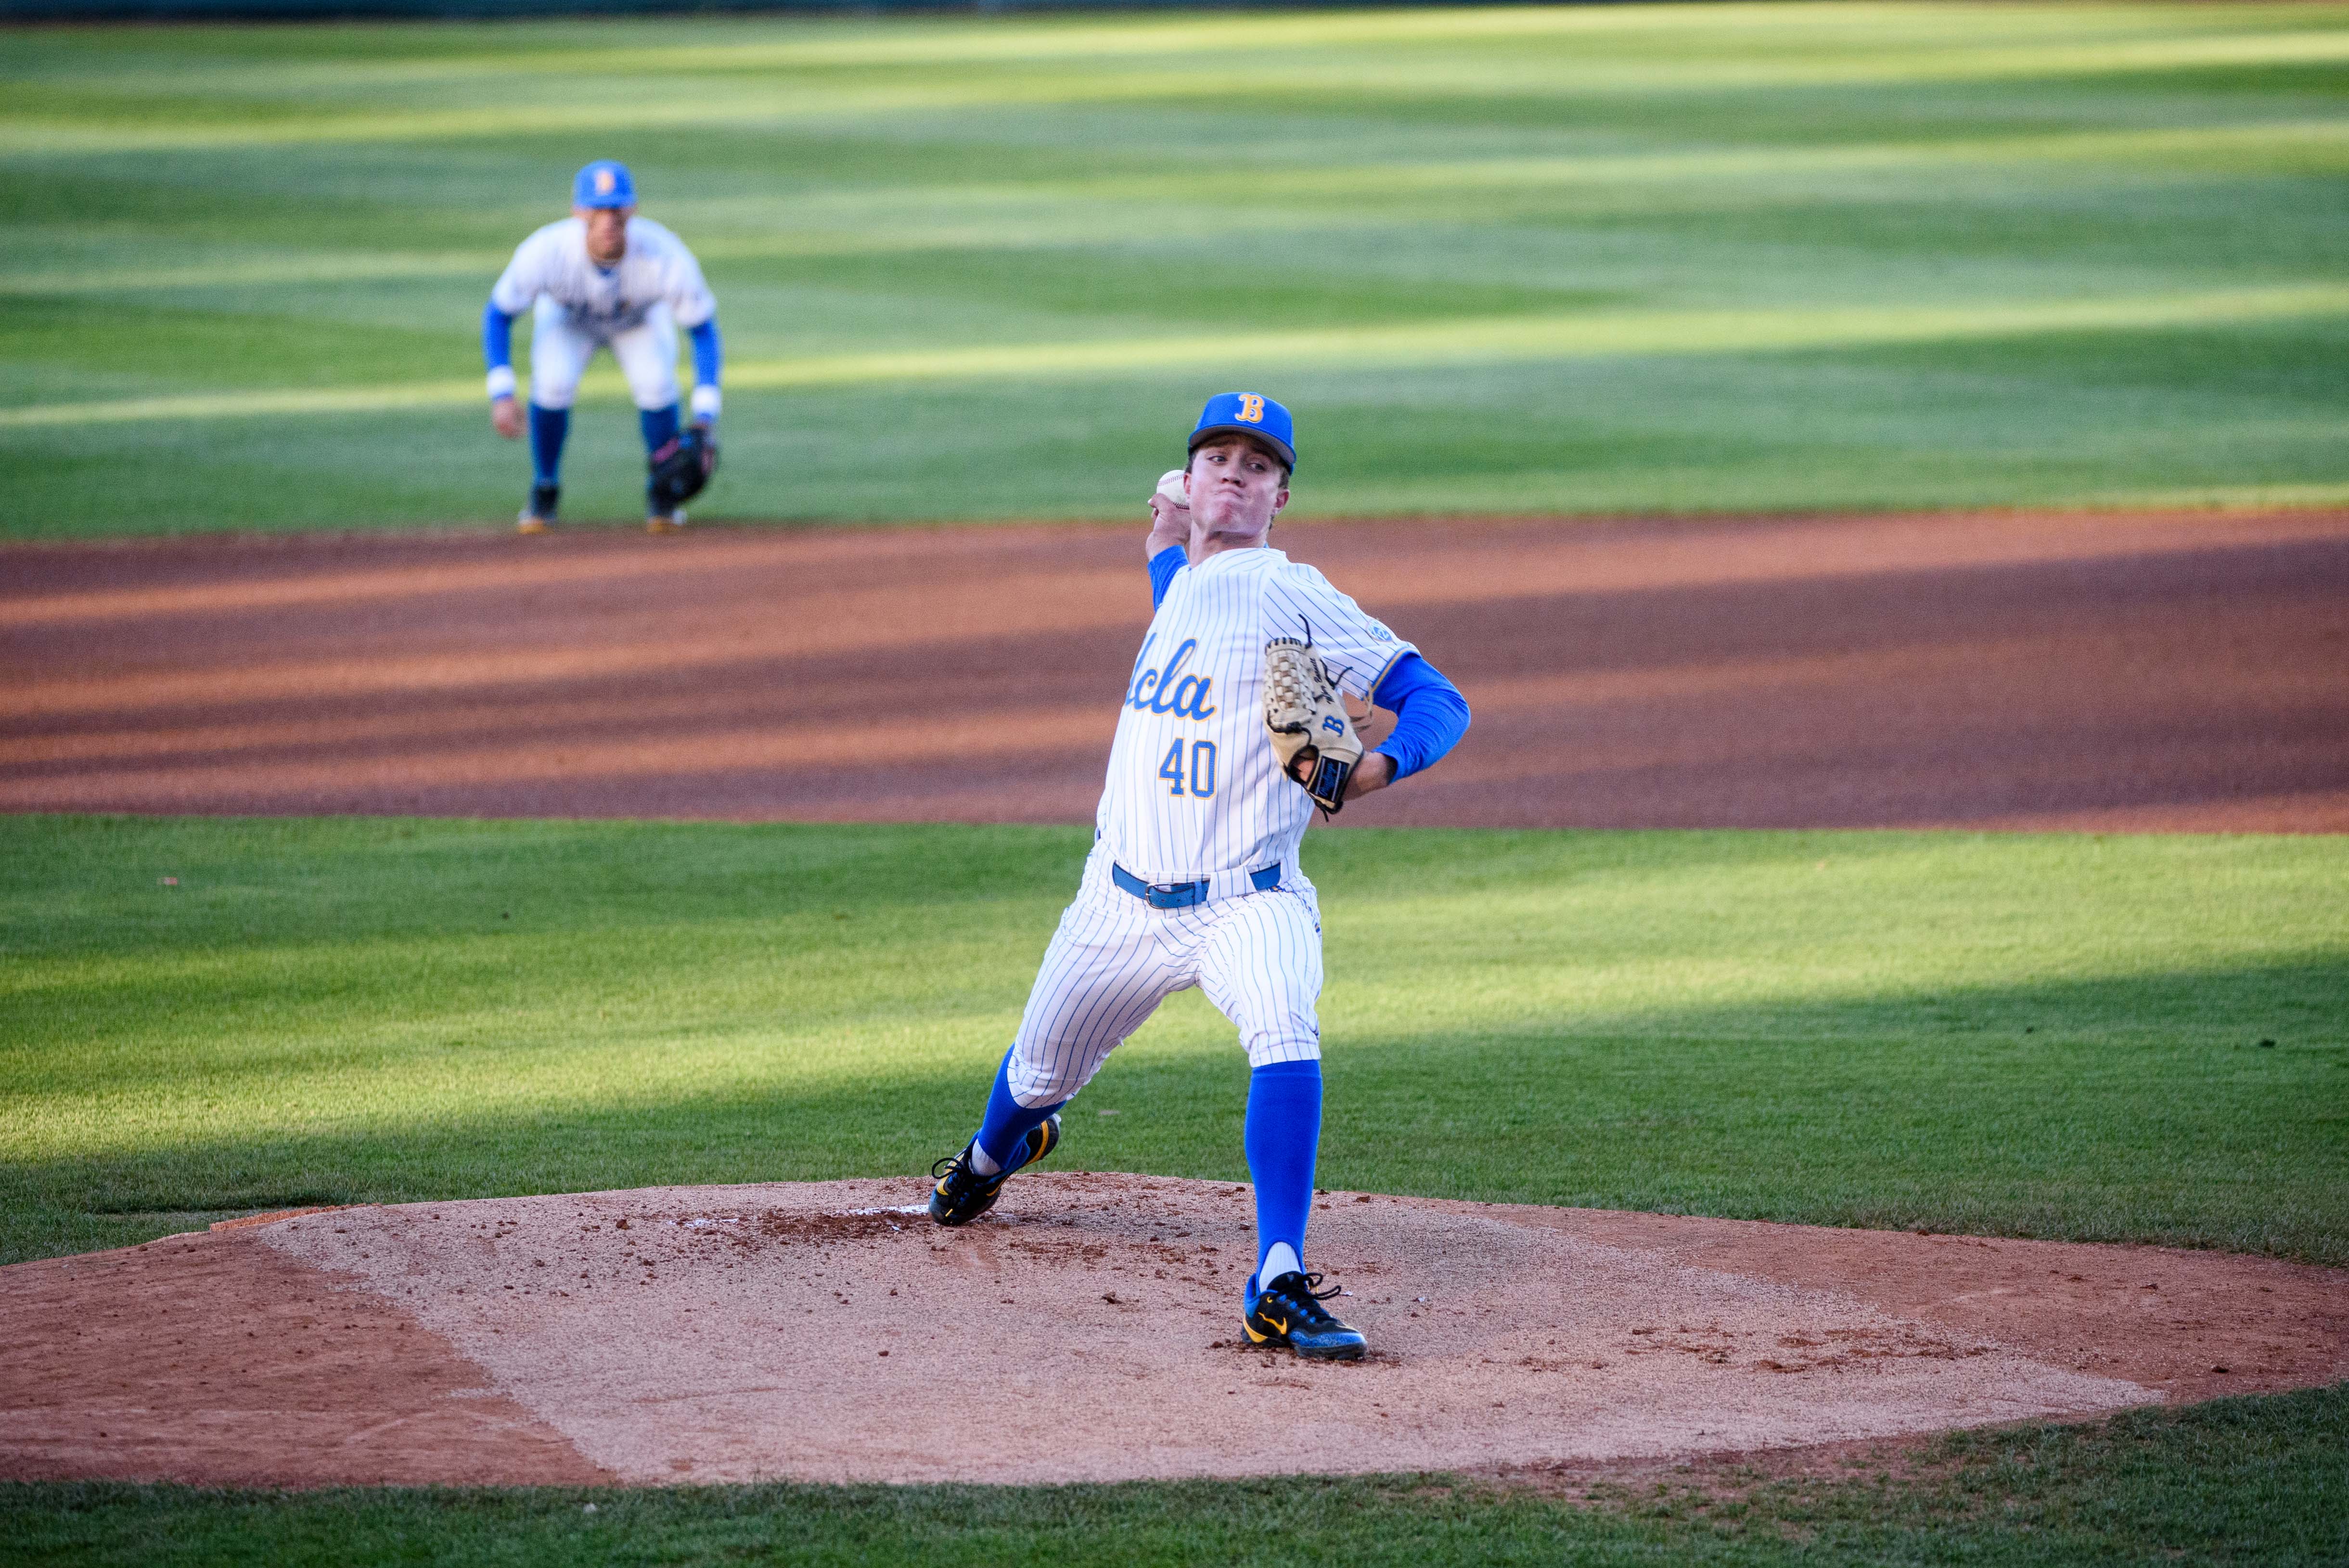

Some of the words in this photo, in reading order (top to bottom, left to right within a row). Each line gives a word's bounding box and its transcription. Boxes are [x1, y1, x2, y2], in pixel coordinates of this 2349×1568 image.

[1235, 393, 1265, 424] B
[1322, 715, 1345, 738] B
[1157, 736, 1219, 800] 40
